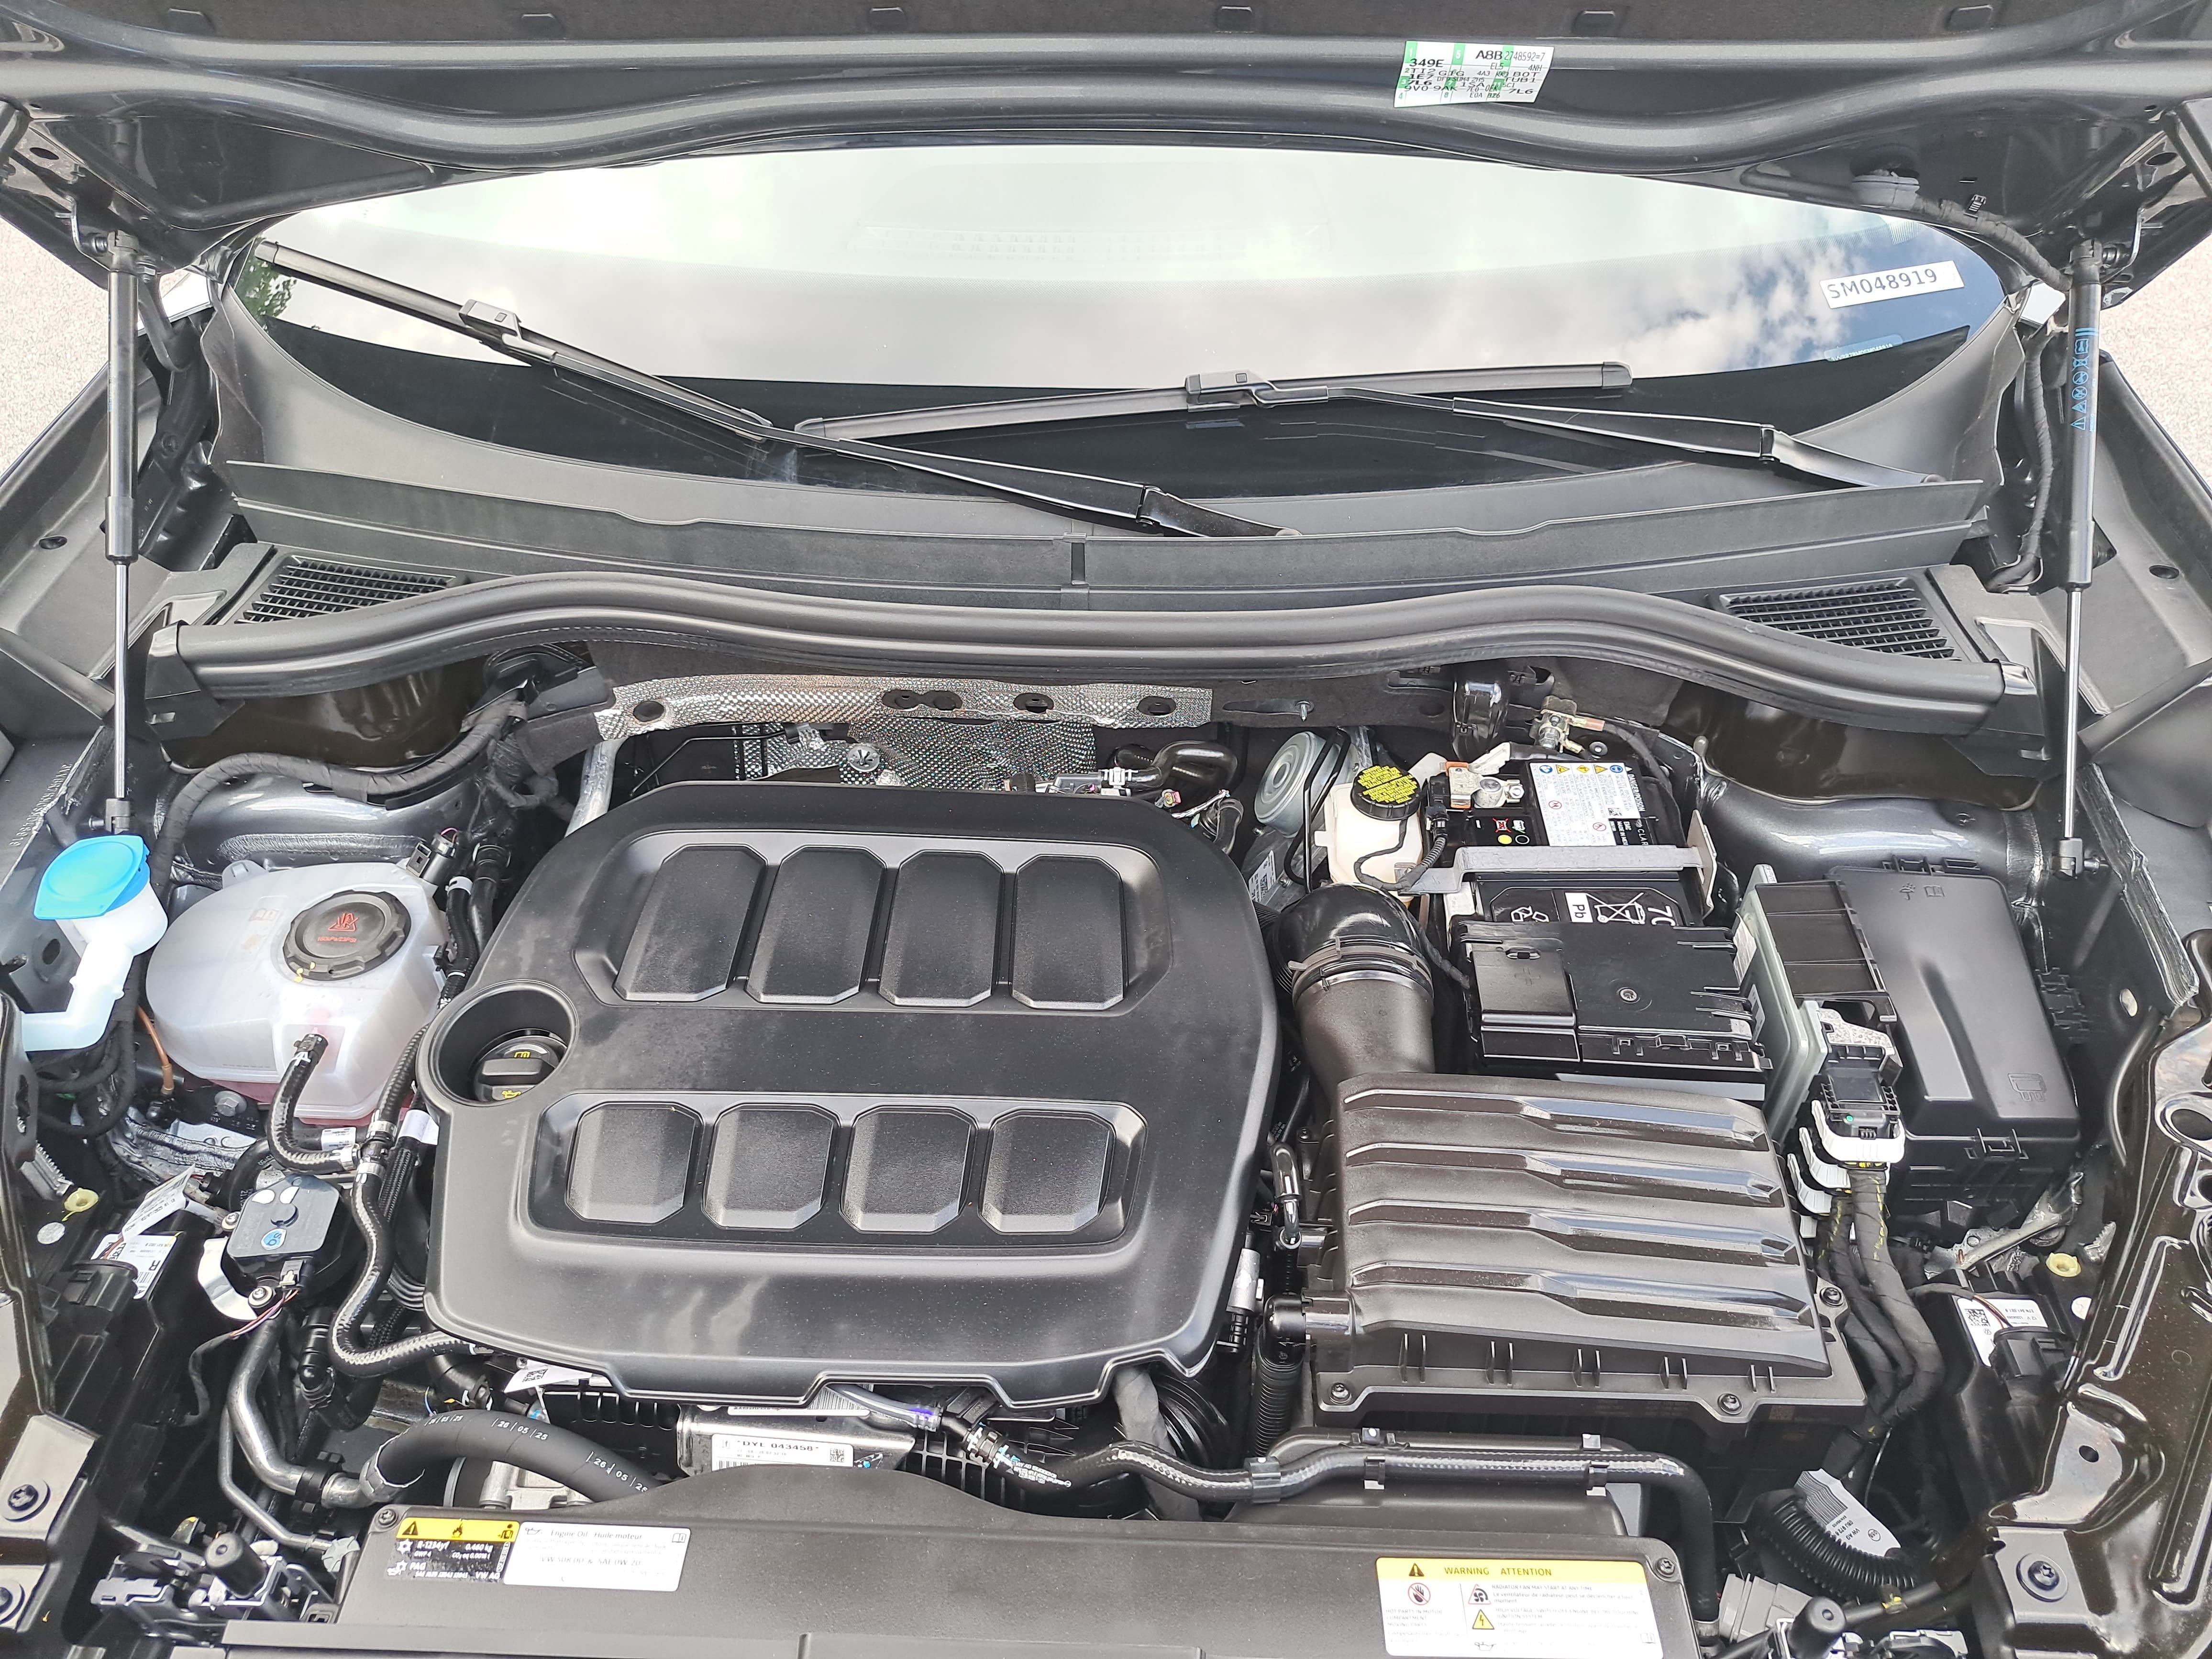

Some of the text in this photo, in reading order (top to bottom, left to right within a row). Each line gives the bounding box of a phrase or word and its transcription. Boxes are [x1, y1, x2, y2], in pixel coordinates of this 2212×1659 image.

[1476, 50, 1546, 62] A8B 2748592=7
[1409, 58, 1444, 67] 349E
[1827, 267, 1938, 300] SM048919
[1572, 904, 1586, 918] Pb
[149, 1261, 161, 1271] R
[551, 1530, 575, 1538] Engine
[409, 1562, 427, 1571] PAG
[476, 1571, 488, 1579] VW
